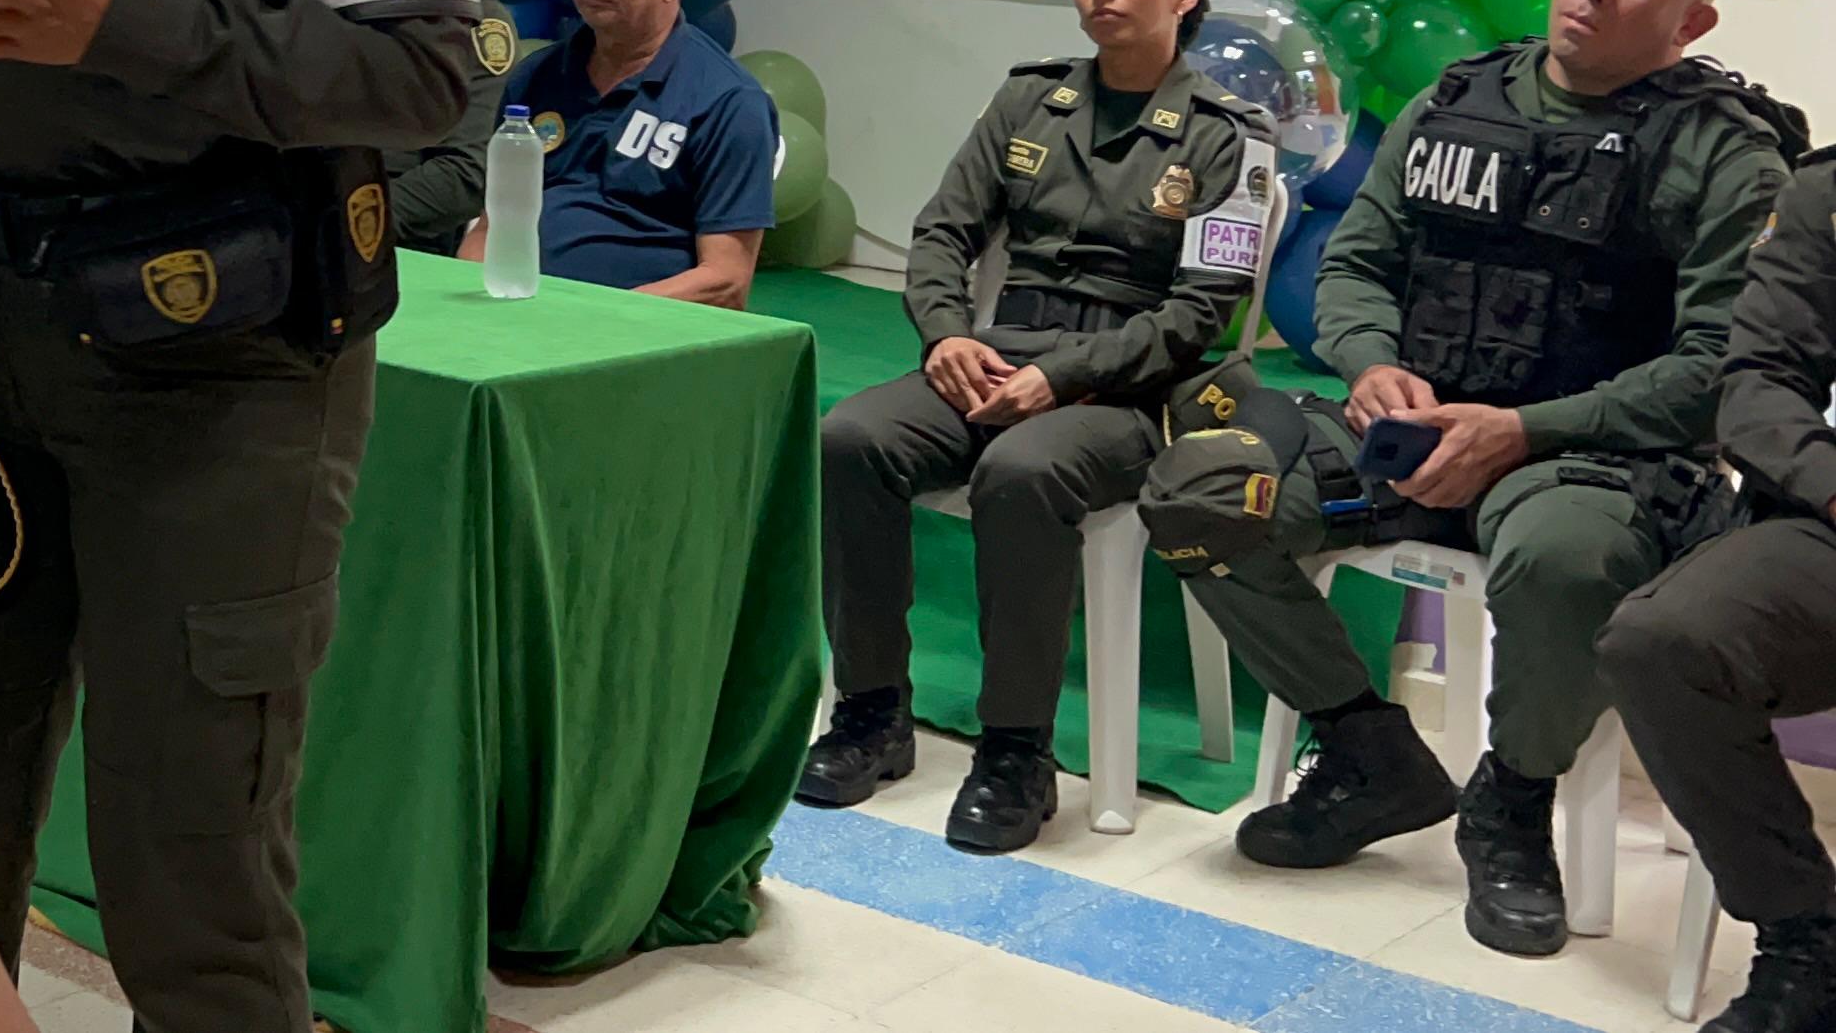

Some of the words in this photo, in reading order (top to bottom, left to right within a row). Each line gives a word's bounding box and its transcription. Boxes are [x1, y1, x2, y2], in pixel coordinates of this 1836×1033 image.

[614, 109, 688, 169] DS
[1404, 136, 1501, 213] GAULA
[1208, 223, 1261, 250] PATR
[1206, 247, 1259, 266] PURP
[1197, 383, 1237, 421] PO
